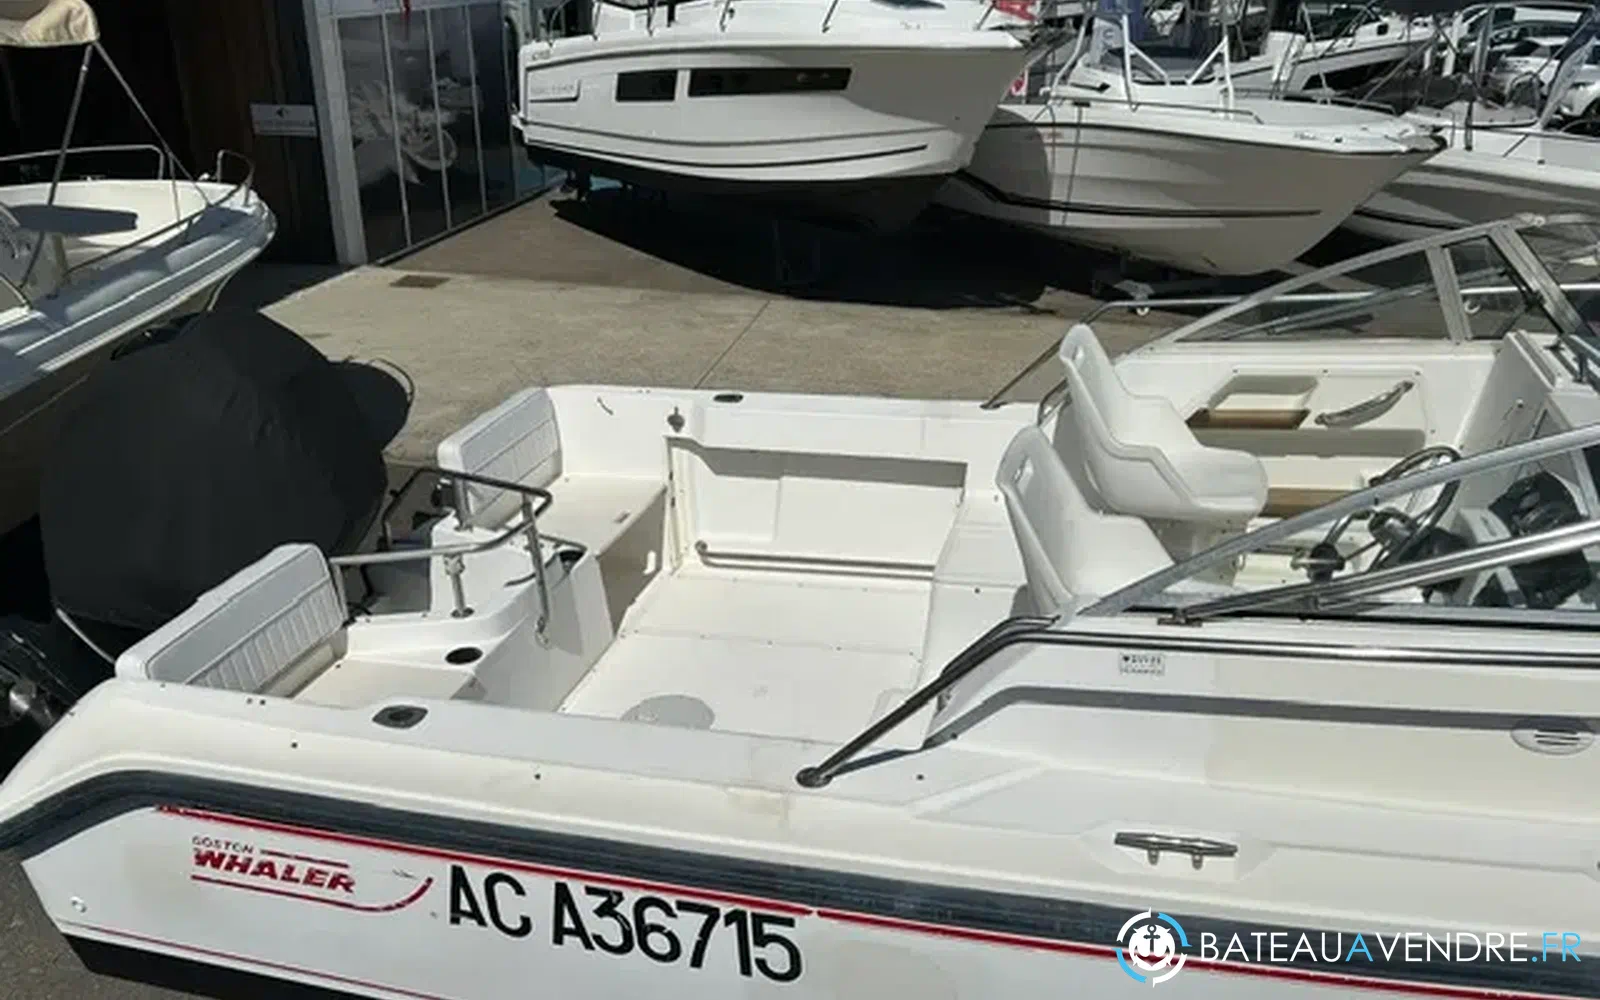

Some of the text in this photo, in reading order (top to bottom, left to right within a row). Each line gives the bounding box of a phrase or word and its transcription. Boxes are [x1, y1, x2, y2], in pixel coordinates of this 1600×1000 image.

[192, 847, 356, 894] WHALER
[449, 865, 803, 983] AC A36715
